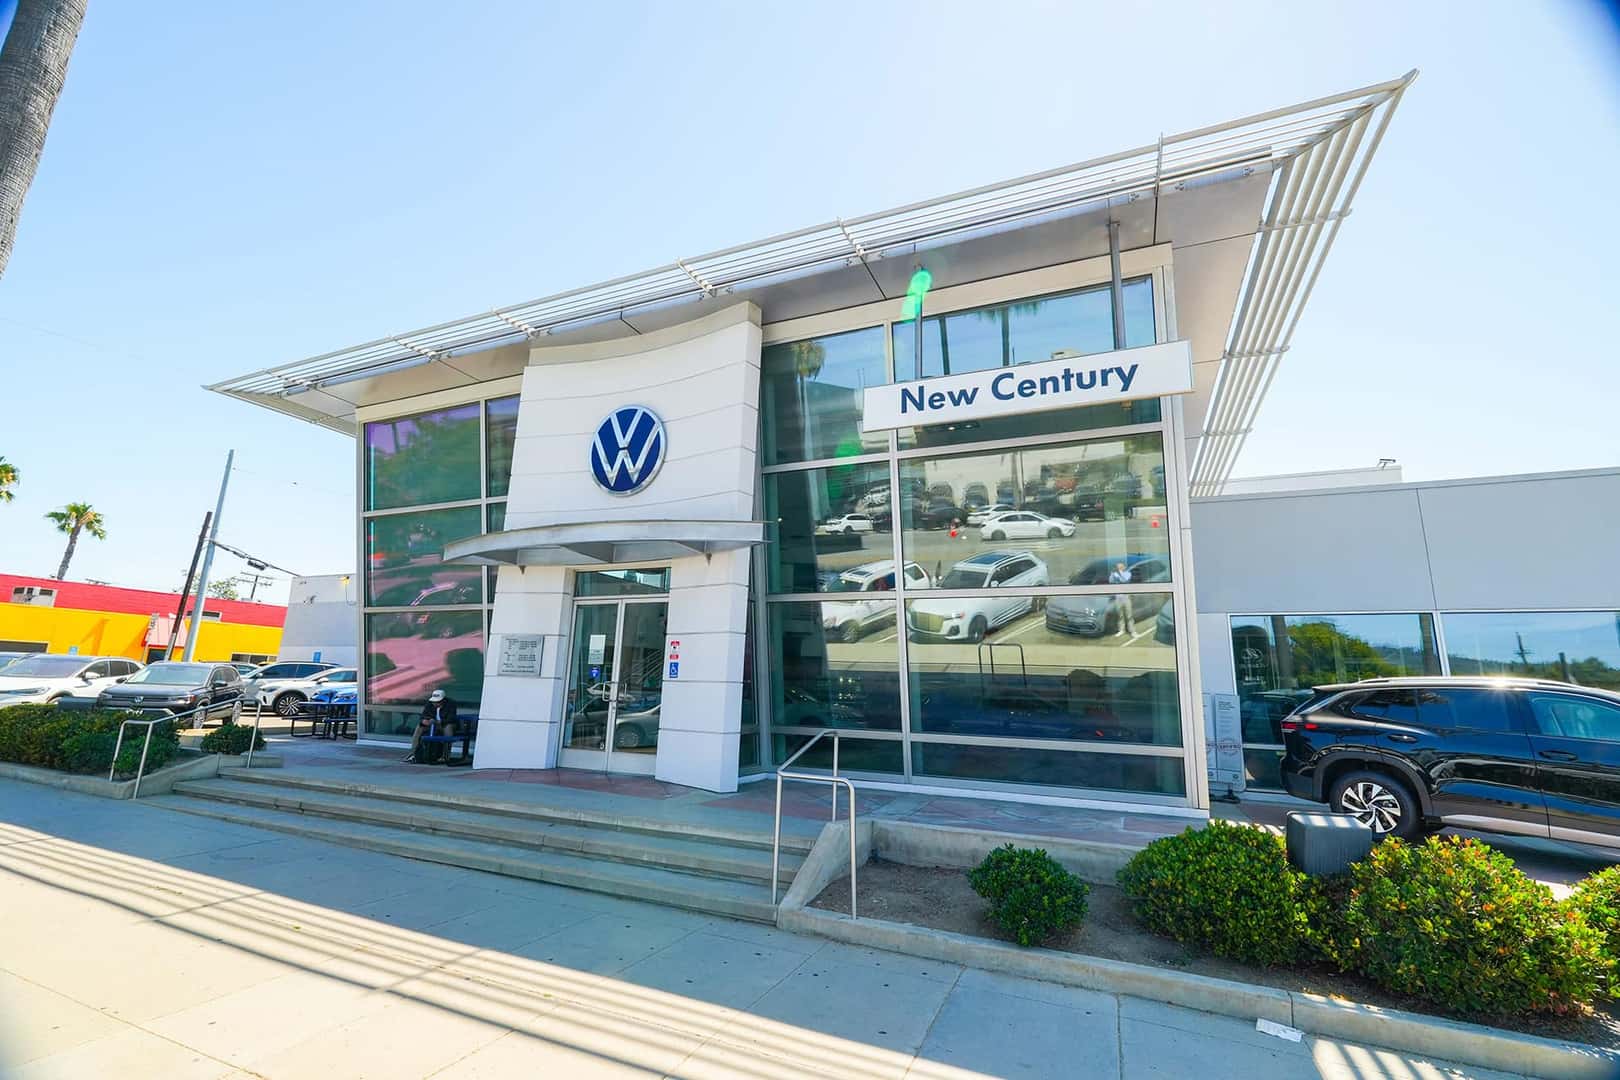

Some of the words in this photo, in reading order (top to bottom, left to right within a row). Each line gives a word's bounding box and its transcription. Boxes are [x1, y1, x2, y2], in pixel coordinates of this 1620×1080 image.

[900, 385, 980, 415] New
[991, 363, 1140, 401] Century
[592, 406, 663, 489] VW
